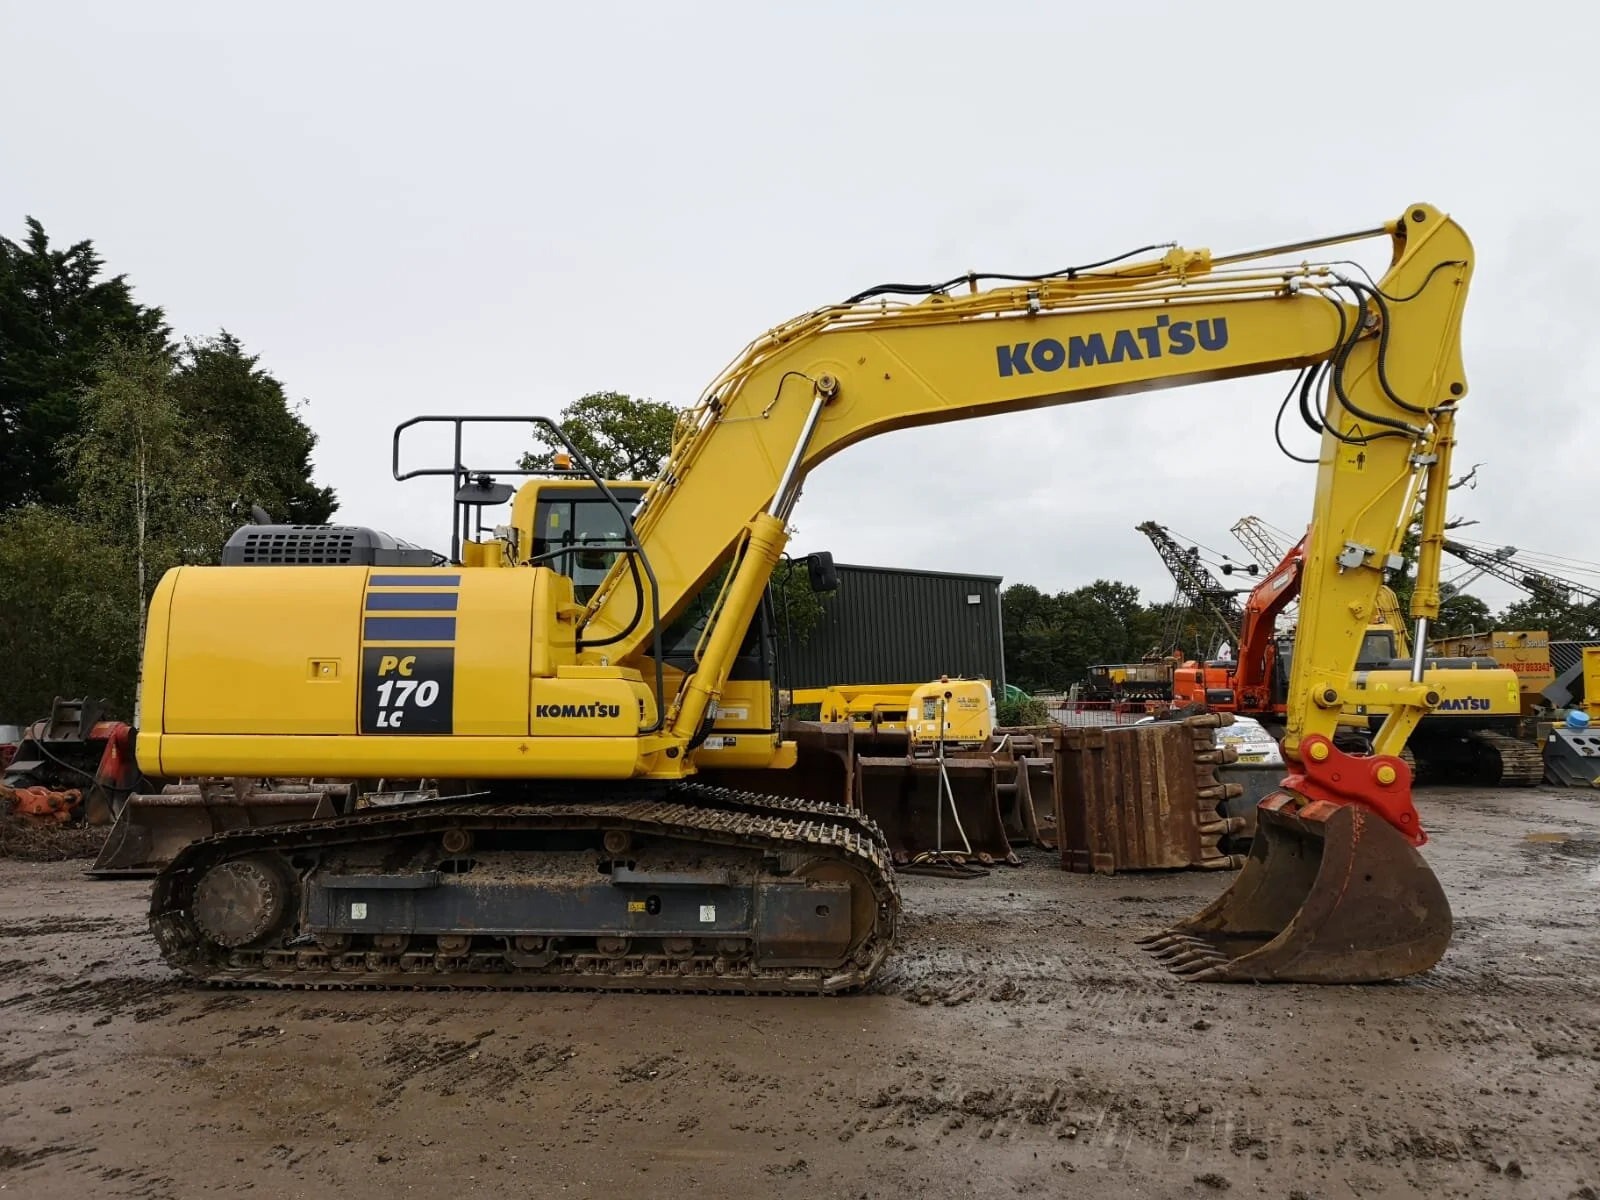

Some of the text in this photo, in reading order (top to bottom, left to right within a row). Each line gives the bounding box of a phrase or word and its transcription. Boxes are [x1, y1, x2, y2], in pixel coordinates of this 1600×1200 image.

[996, 314, 1229, 377] KOMATSU
[378, 656, 416, 676] PC
[377, 680, 439, 707] 170
[536, 702, 620, 717] KOMATSU
[1437, 696, 1490, 710] MATSU
[376, 711, 403, 727] LC
